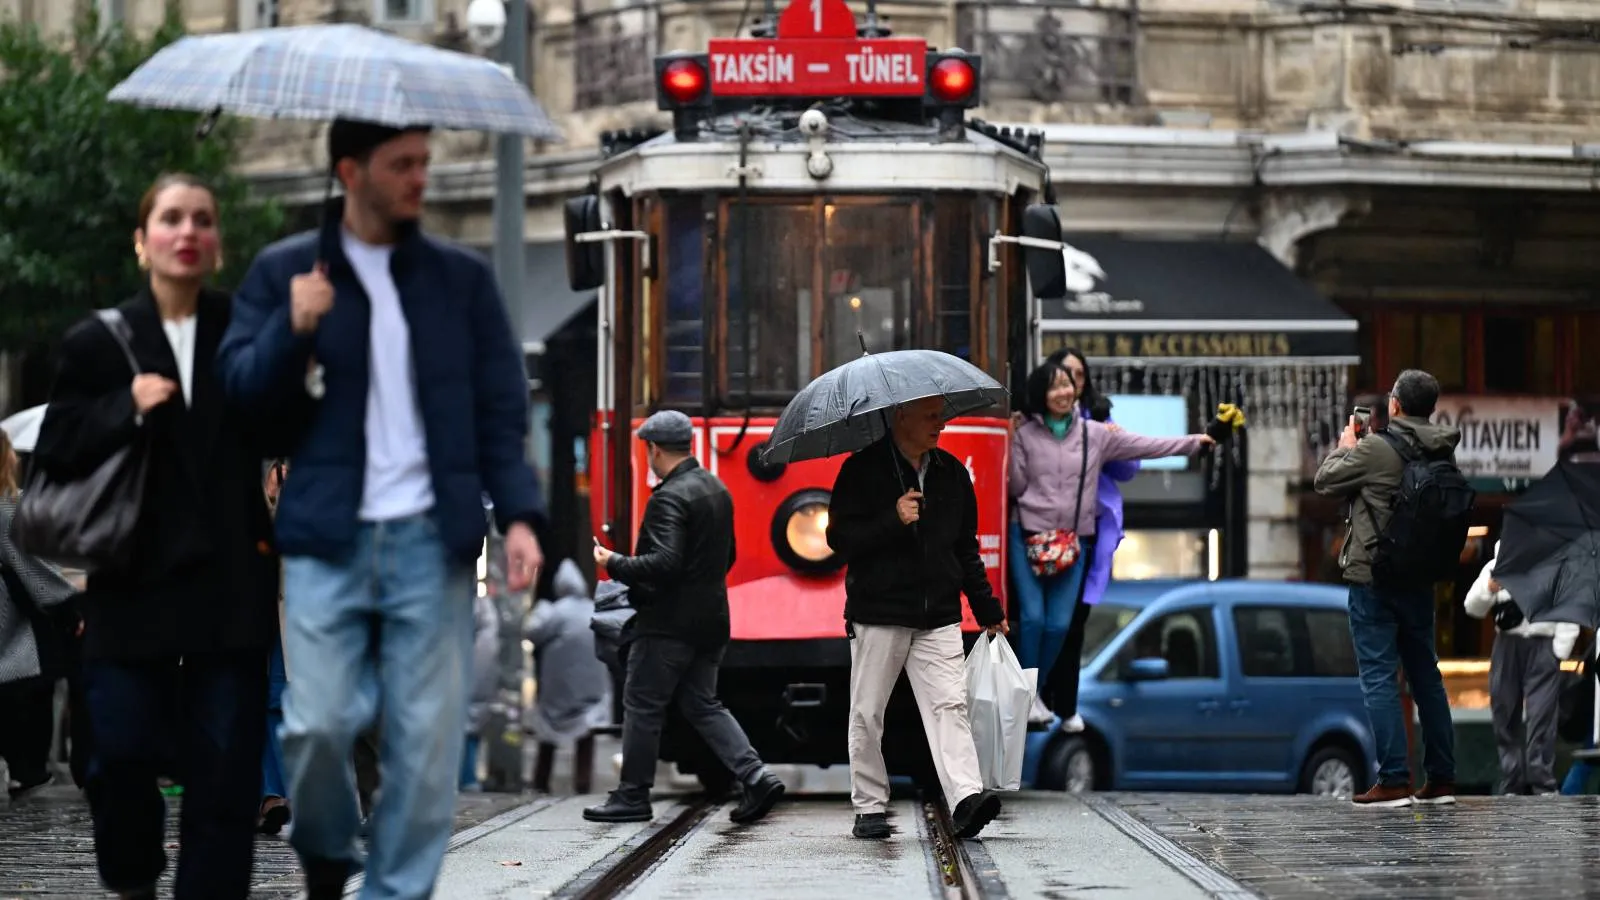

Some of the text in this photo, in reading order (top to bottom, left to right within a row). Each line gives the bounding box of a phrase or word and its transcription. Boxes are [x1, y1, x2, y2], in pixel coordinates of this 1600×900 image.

[810, 0, 823, 32] 1
[712, 47, 794, 84] TAKSİM
[846, 47, 919, 84] TÜNEL
[1139, 333, 1291, 357] ACCESSORIES
